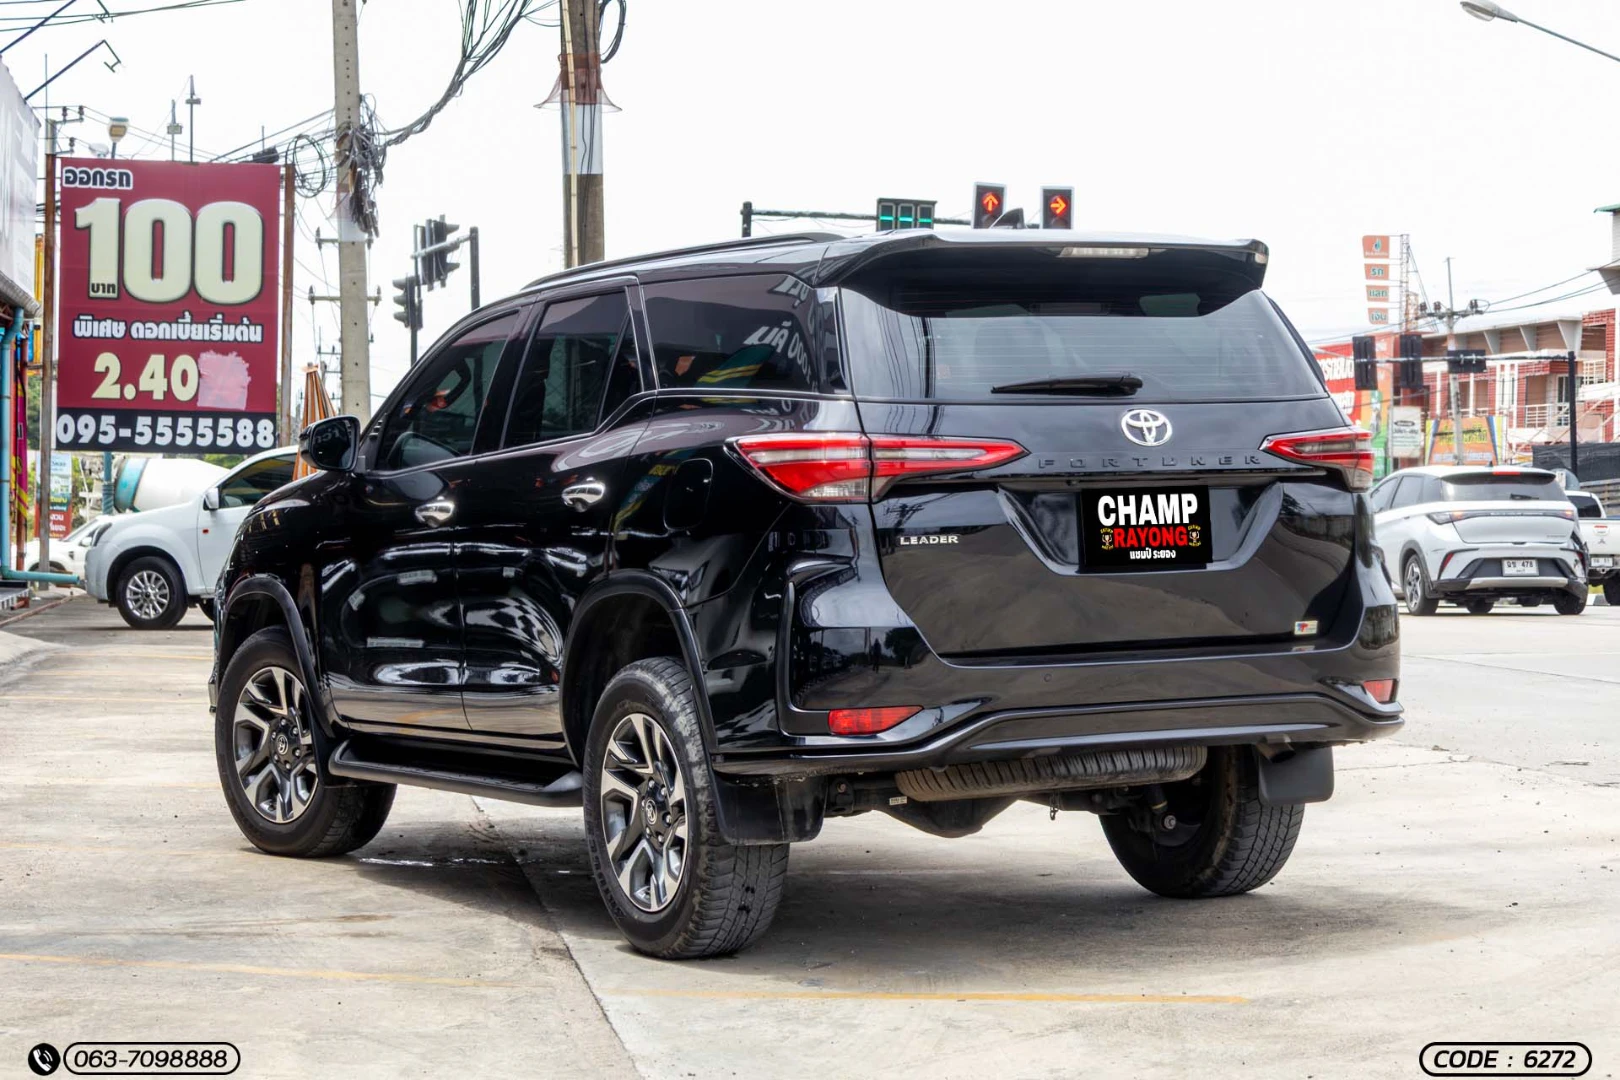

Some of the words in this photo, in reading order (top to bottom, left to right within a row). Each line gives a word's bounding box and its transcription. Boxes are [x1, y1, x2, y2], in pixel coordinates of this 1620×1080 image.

[63, 168, 132, 188] ออกรถ
[75, 197, 263, 305] 100
[91, 282, 116, 294] บาท
[74, 315, 127, 338] พิเศษ
[130, 311, 263, 342] ดอกเบี้ยเริ่มต้น
[91, 352, 199, 400] 2.40
[56, 414, 275, 447] 095-5555588
[1038, 454, 1261, 470] FORTUNER
[1097, 493, 1198, 526] CHAMP
[900, 535, 959, 545] LEADER
[1113, 526, 1188, 548] RAYONG
